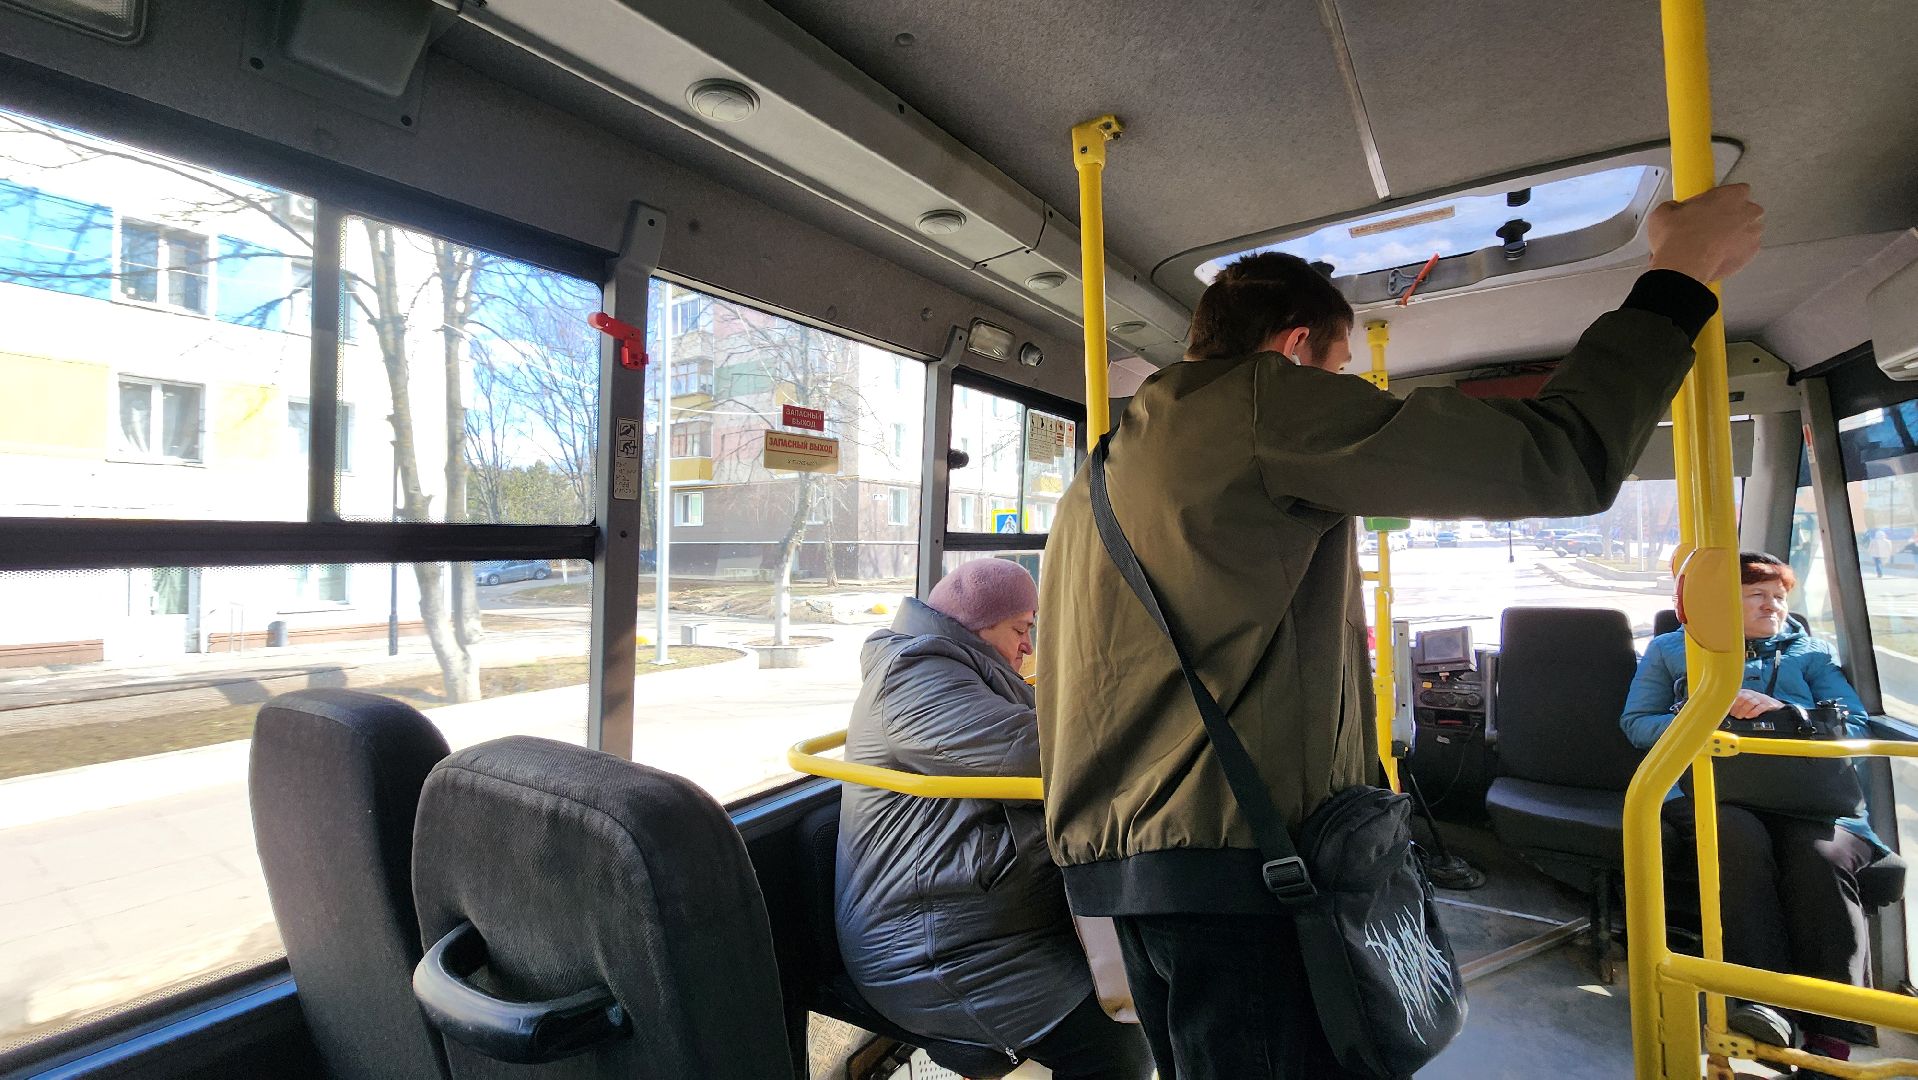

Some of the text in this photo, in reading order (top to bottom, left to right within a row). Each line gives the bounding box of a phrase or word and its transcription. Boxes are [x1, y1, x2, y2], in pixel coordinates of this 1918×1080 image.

[792, 418, 816, 428] ВЫХОД
[769, 437, 833, 454] ЗАПАСНЫЙ ВЫХОД
